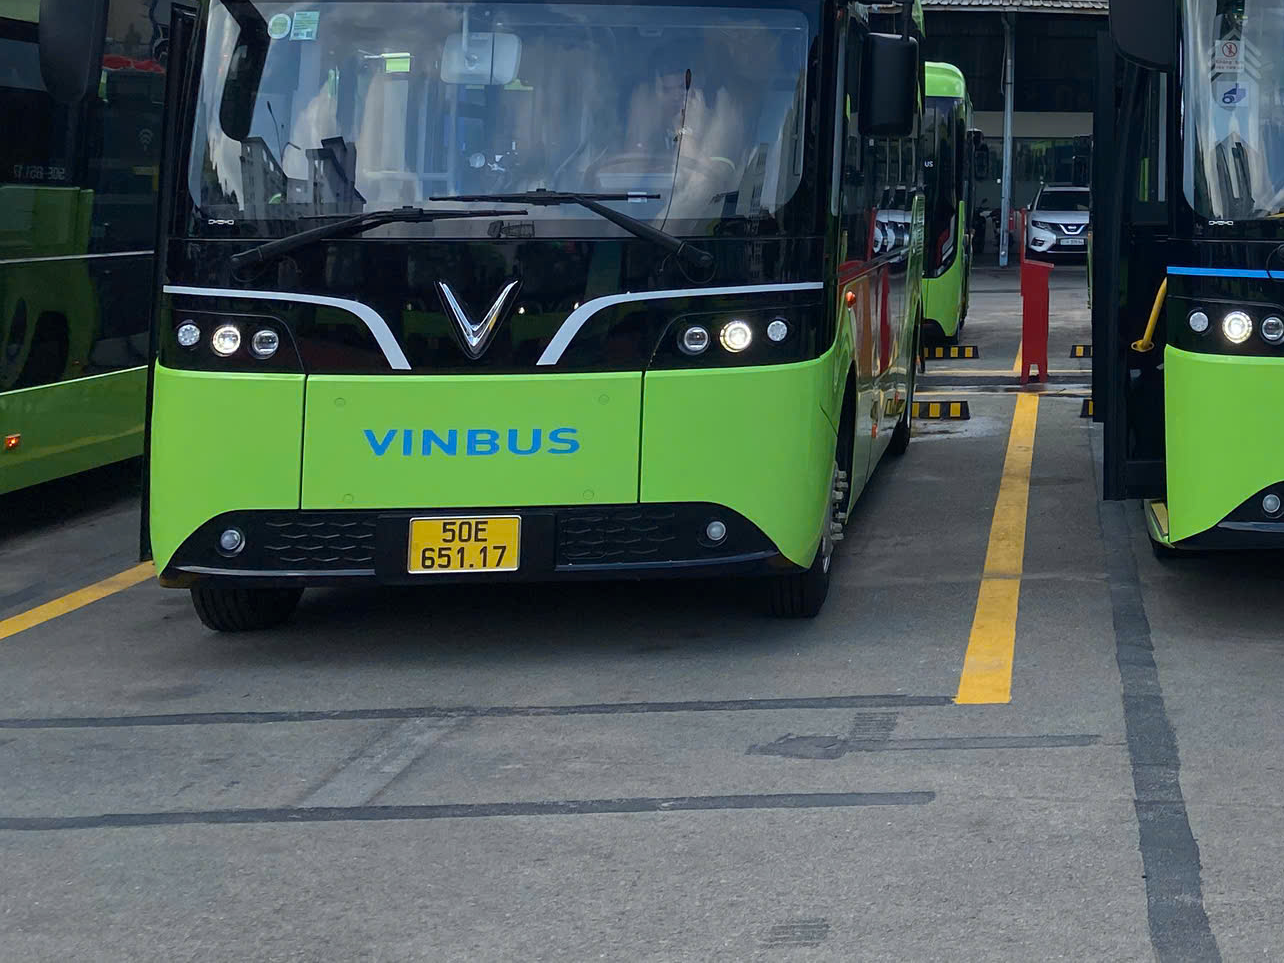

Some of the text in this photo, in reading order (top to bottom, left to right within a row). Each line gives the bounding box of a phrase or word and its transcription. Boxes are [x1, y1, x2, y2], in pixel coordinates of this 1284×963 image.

[364, 427, 581, 457] VINBUS
[441, 520, 489, 543] 50E
[420, 545, 507, 569] 651.17
